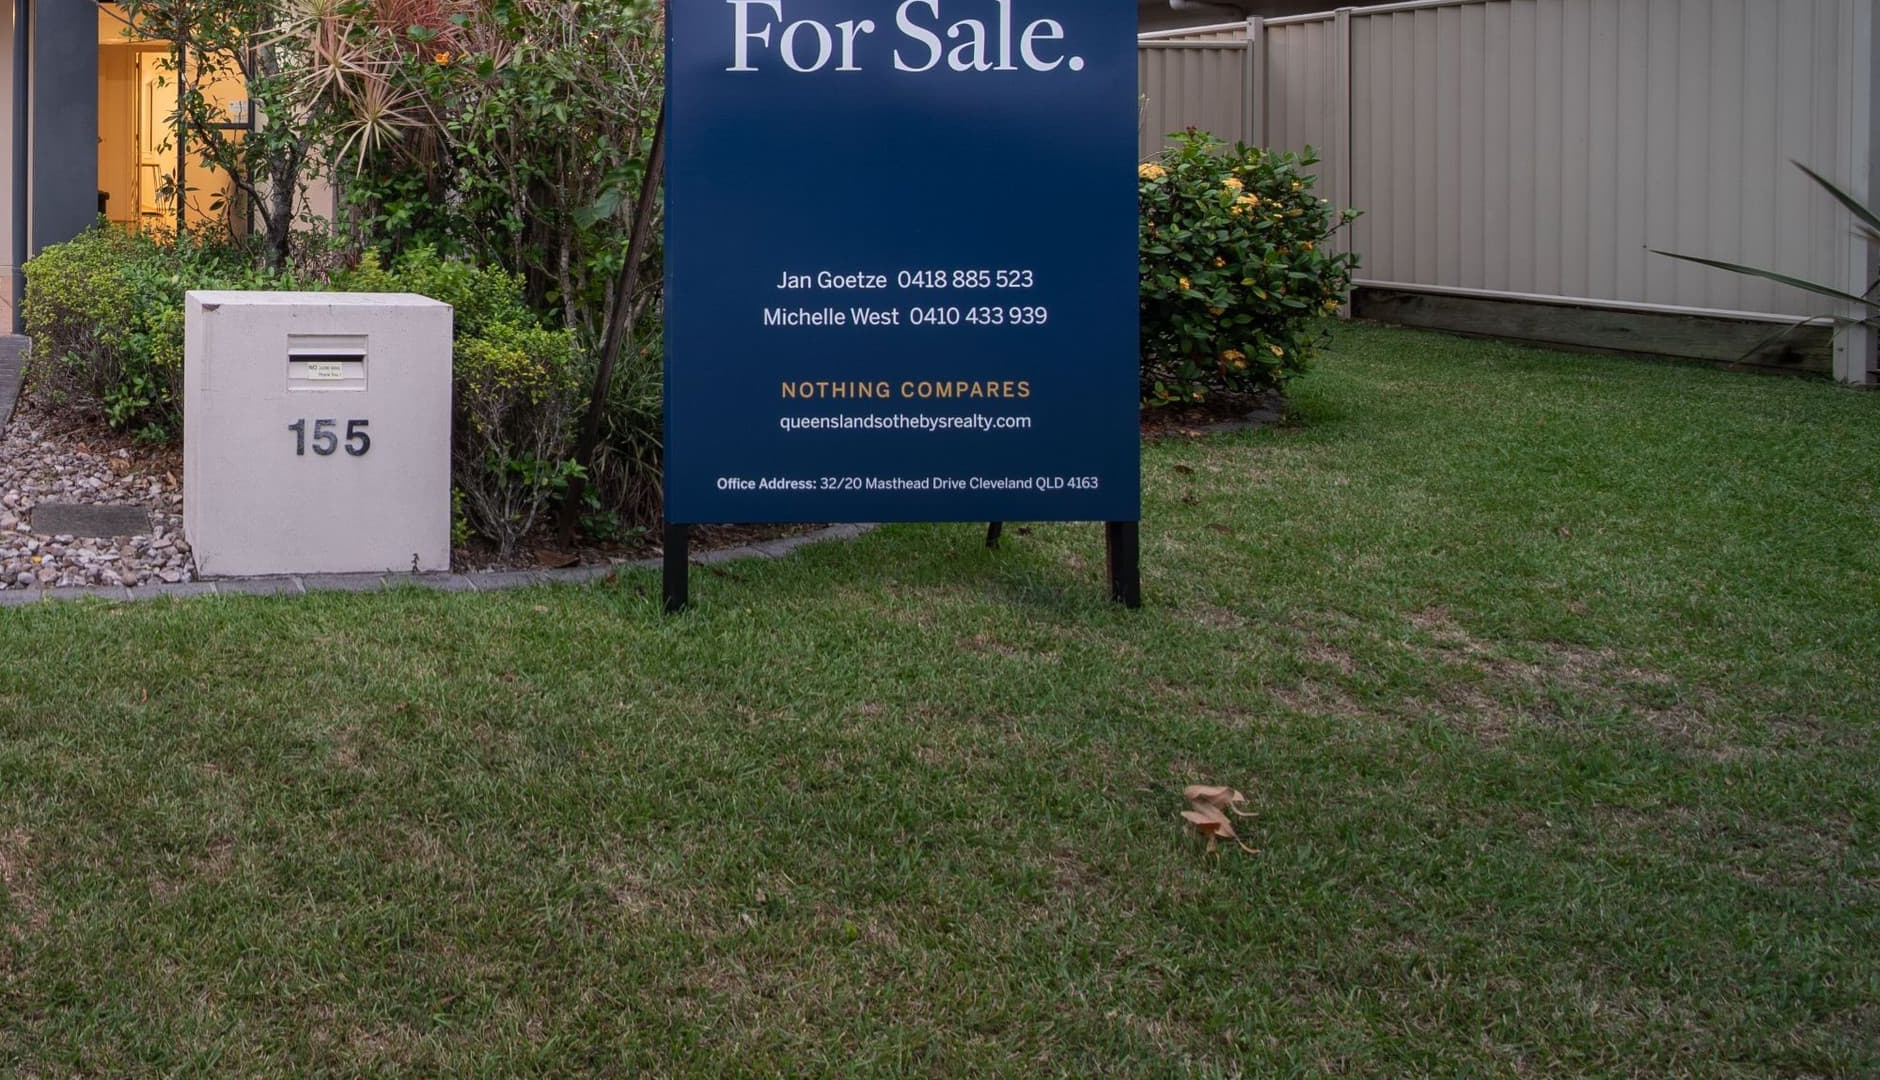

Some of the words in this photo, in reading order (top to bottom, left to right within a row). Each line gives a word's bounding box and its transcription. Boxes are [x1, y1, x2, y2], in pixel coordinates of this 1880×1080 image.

[725, 0, 875, 73] For
[776, 271, 812, 289] Jan
[817, 270, 888, 289] Goetze
[897, 270, 948, 289] 0418
[952, 269, 991, 289] 885
[995, 269, 1034, 288] 523
[763, 307, 846, 326] Michelle
[850, 307, 900, 326] West
[909, 306, 960, 326] 0410
[965, 306, 1004, 325] 433
[1008, 306, 1048, 325] 939
[781, 381, 890, 399] NOTHING
[900, 380, 1031, 399] COMPARES
[779, 413, 1032, 432] queenslandsothebysrealty.com
[288, 418, 371, 456] 155
[716, 477, 757, 490] Office
[758, 477, 817, 490] Address:
[820, 476, 862, 490] 32/20
[865, 476, 930, 490] Masthead
[932, 476, 967, 490] Drive
[969, 476, 1033, 490] Cleveland
[1035, 476, 1065, 491] QLD
[1066, 476, 1100, 489] 4163
